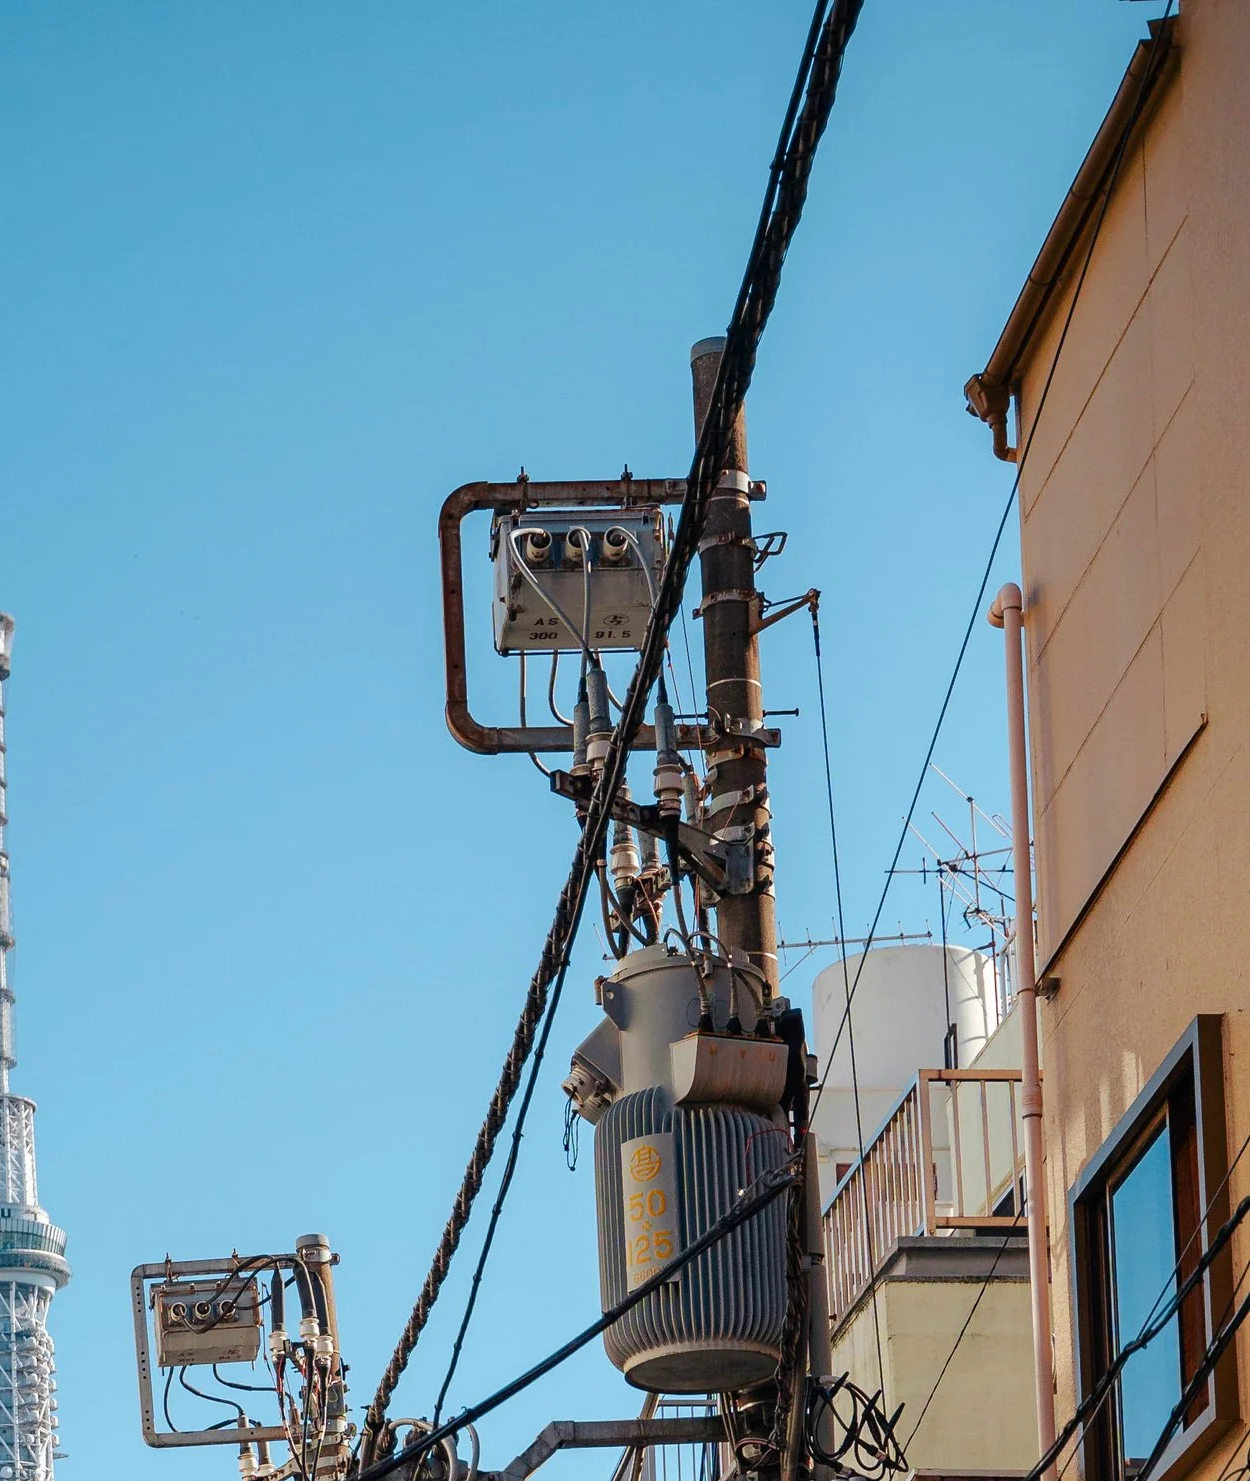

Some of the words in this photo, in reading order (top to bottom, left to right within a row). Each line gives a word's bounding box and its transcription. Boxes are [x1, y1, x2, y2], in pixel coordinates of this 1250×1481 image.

[529, 632, 558, 640] 300
[629, 1188, 667, 1222] 50
[627, 1230, 673, 1267] 125
